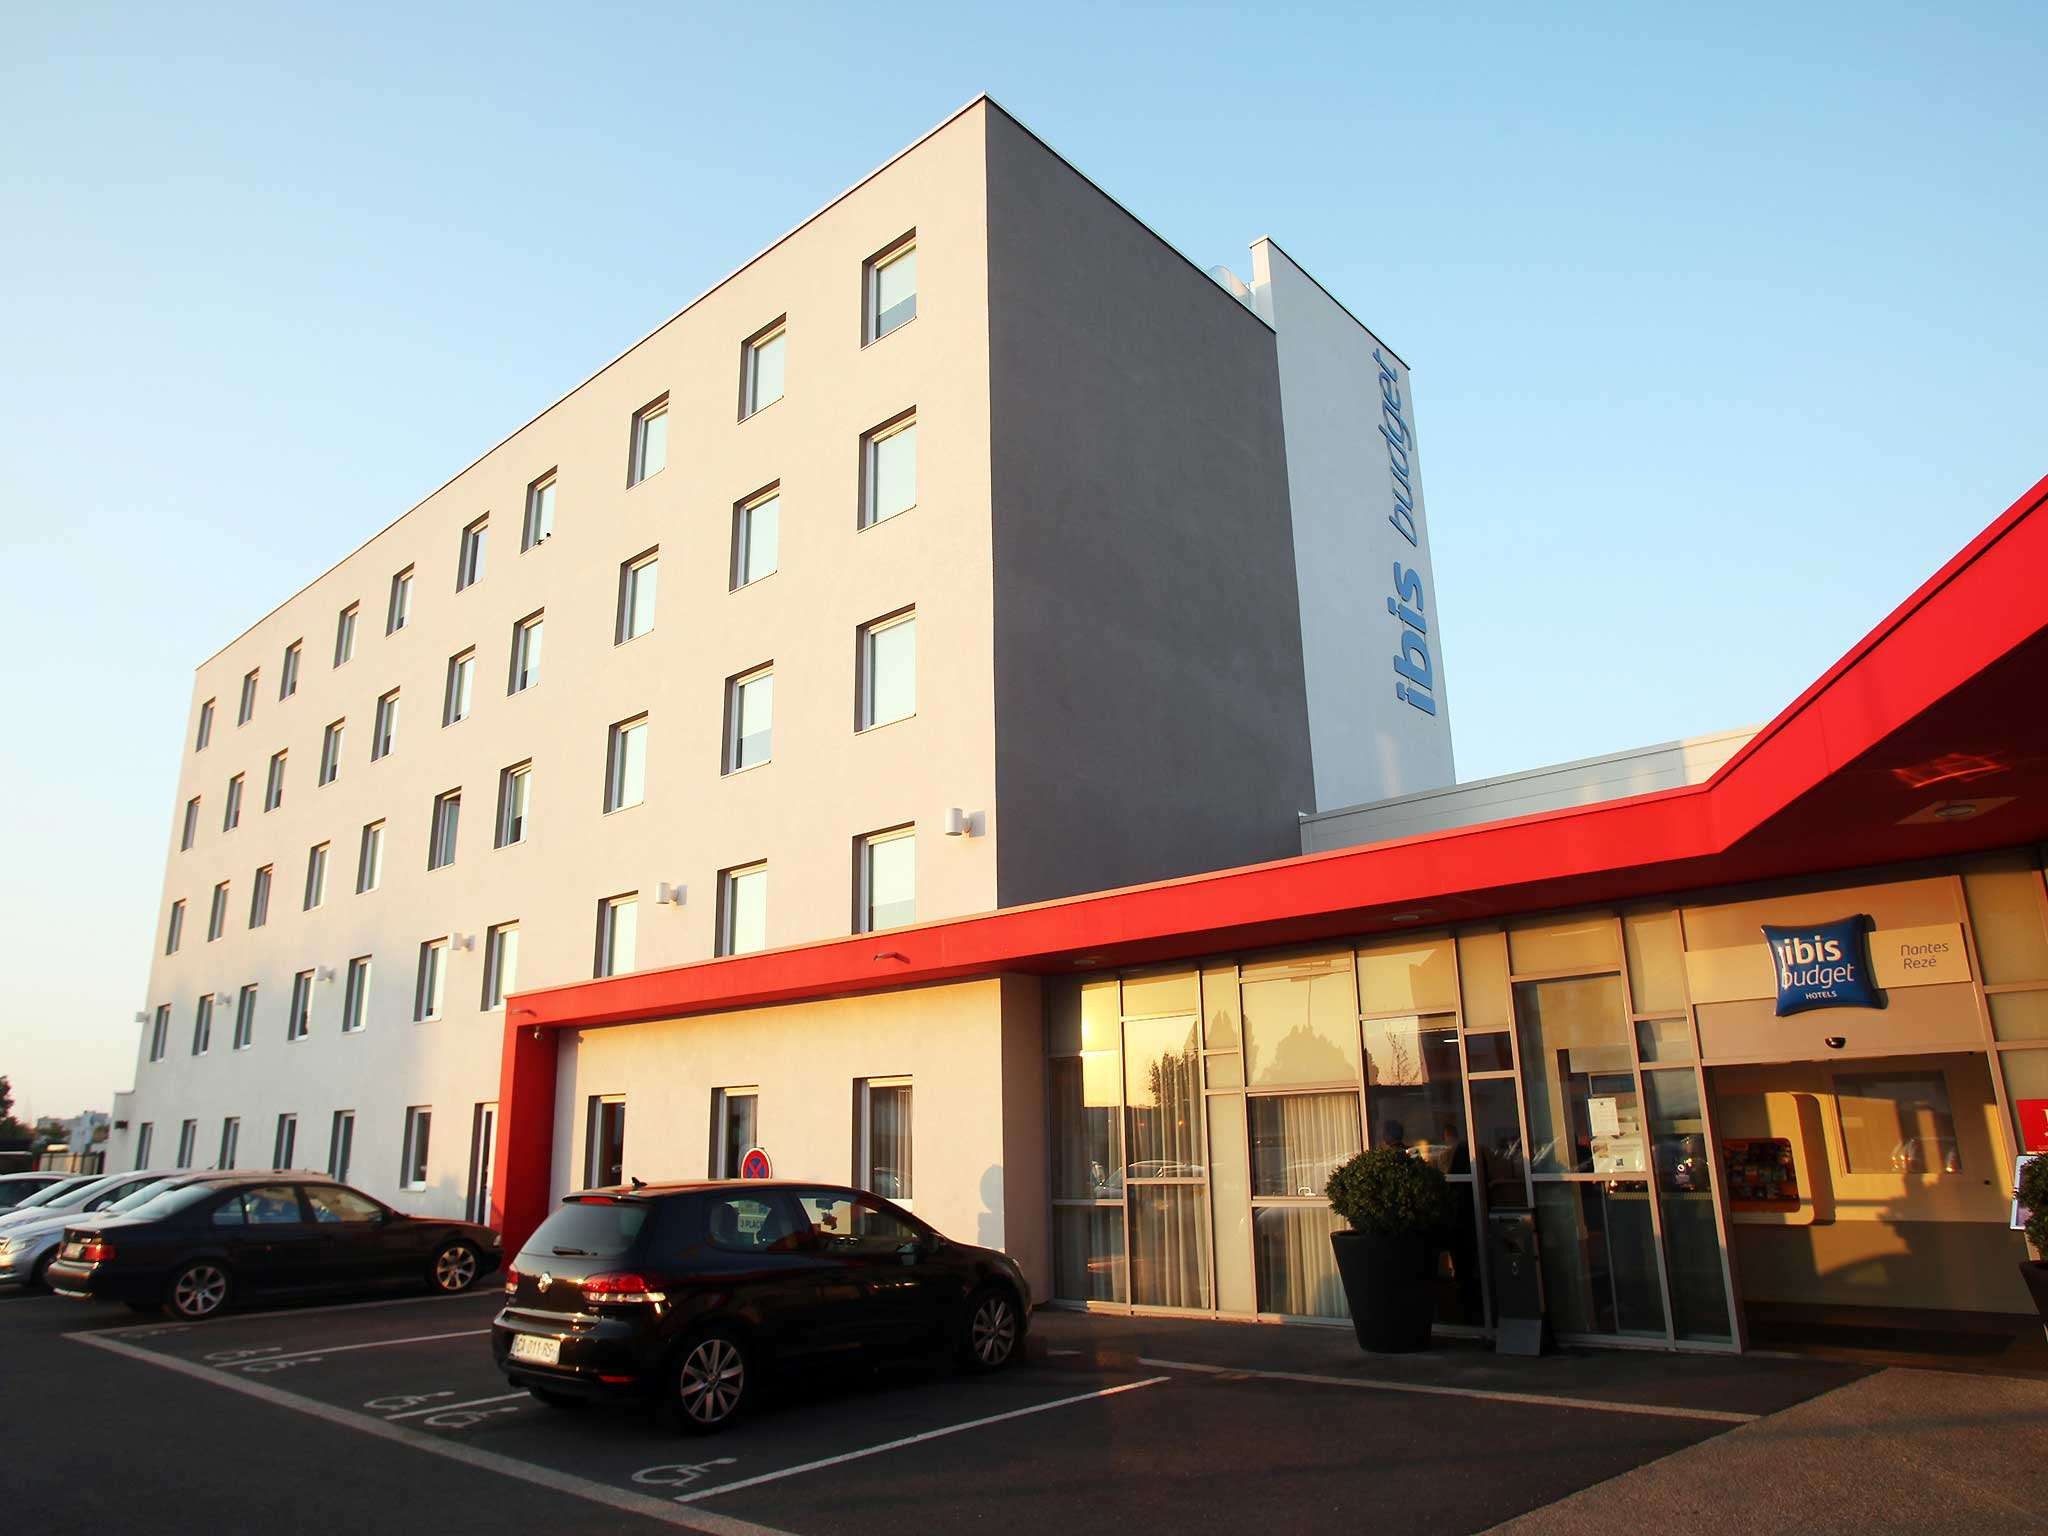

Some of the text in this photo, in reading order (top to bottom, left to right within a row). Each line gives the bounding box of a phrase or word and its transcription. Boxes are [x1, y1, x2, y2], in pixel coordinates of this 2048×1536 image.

[1373, 348, 1436, 716] ibis budget
[1783, 935, 1842, 966] ibis
[1903, 956, 1937, 970] Rezé
[1780, 963, 1855, 989] budget
[1805, 990, 1838, 1000] HOTELS
